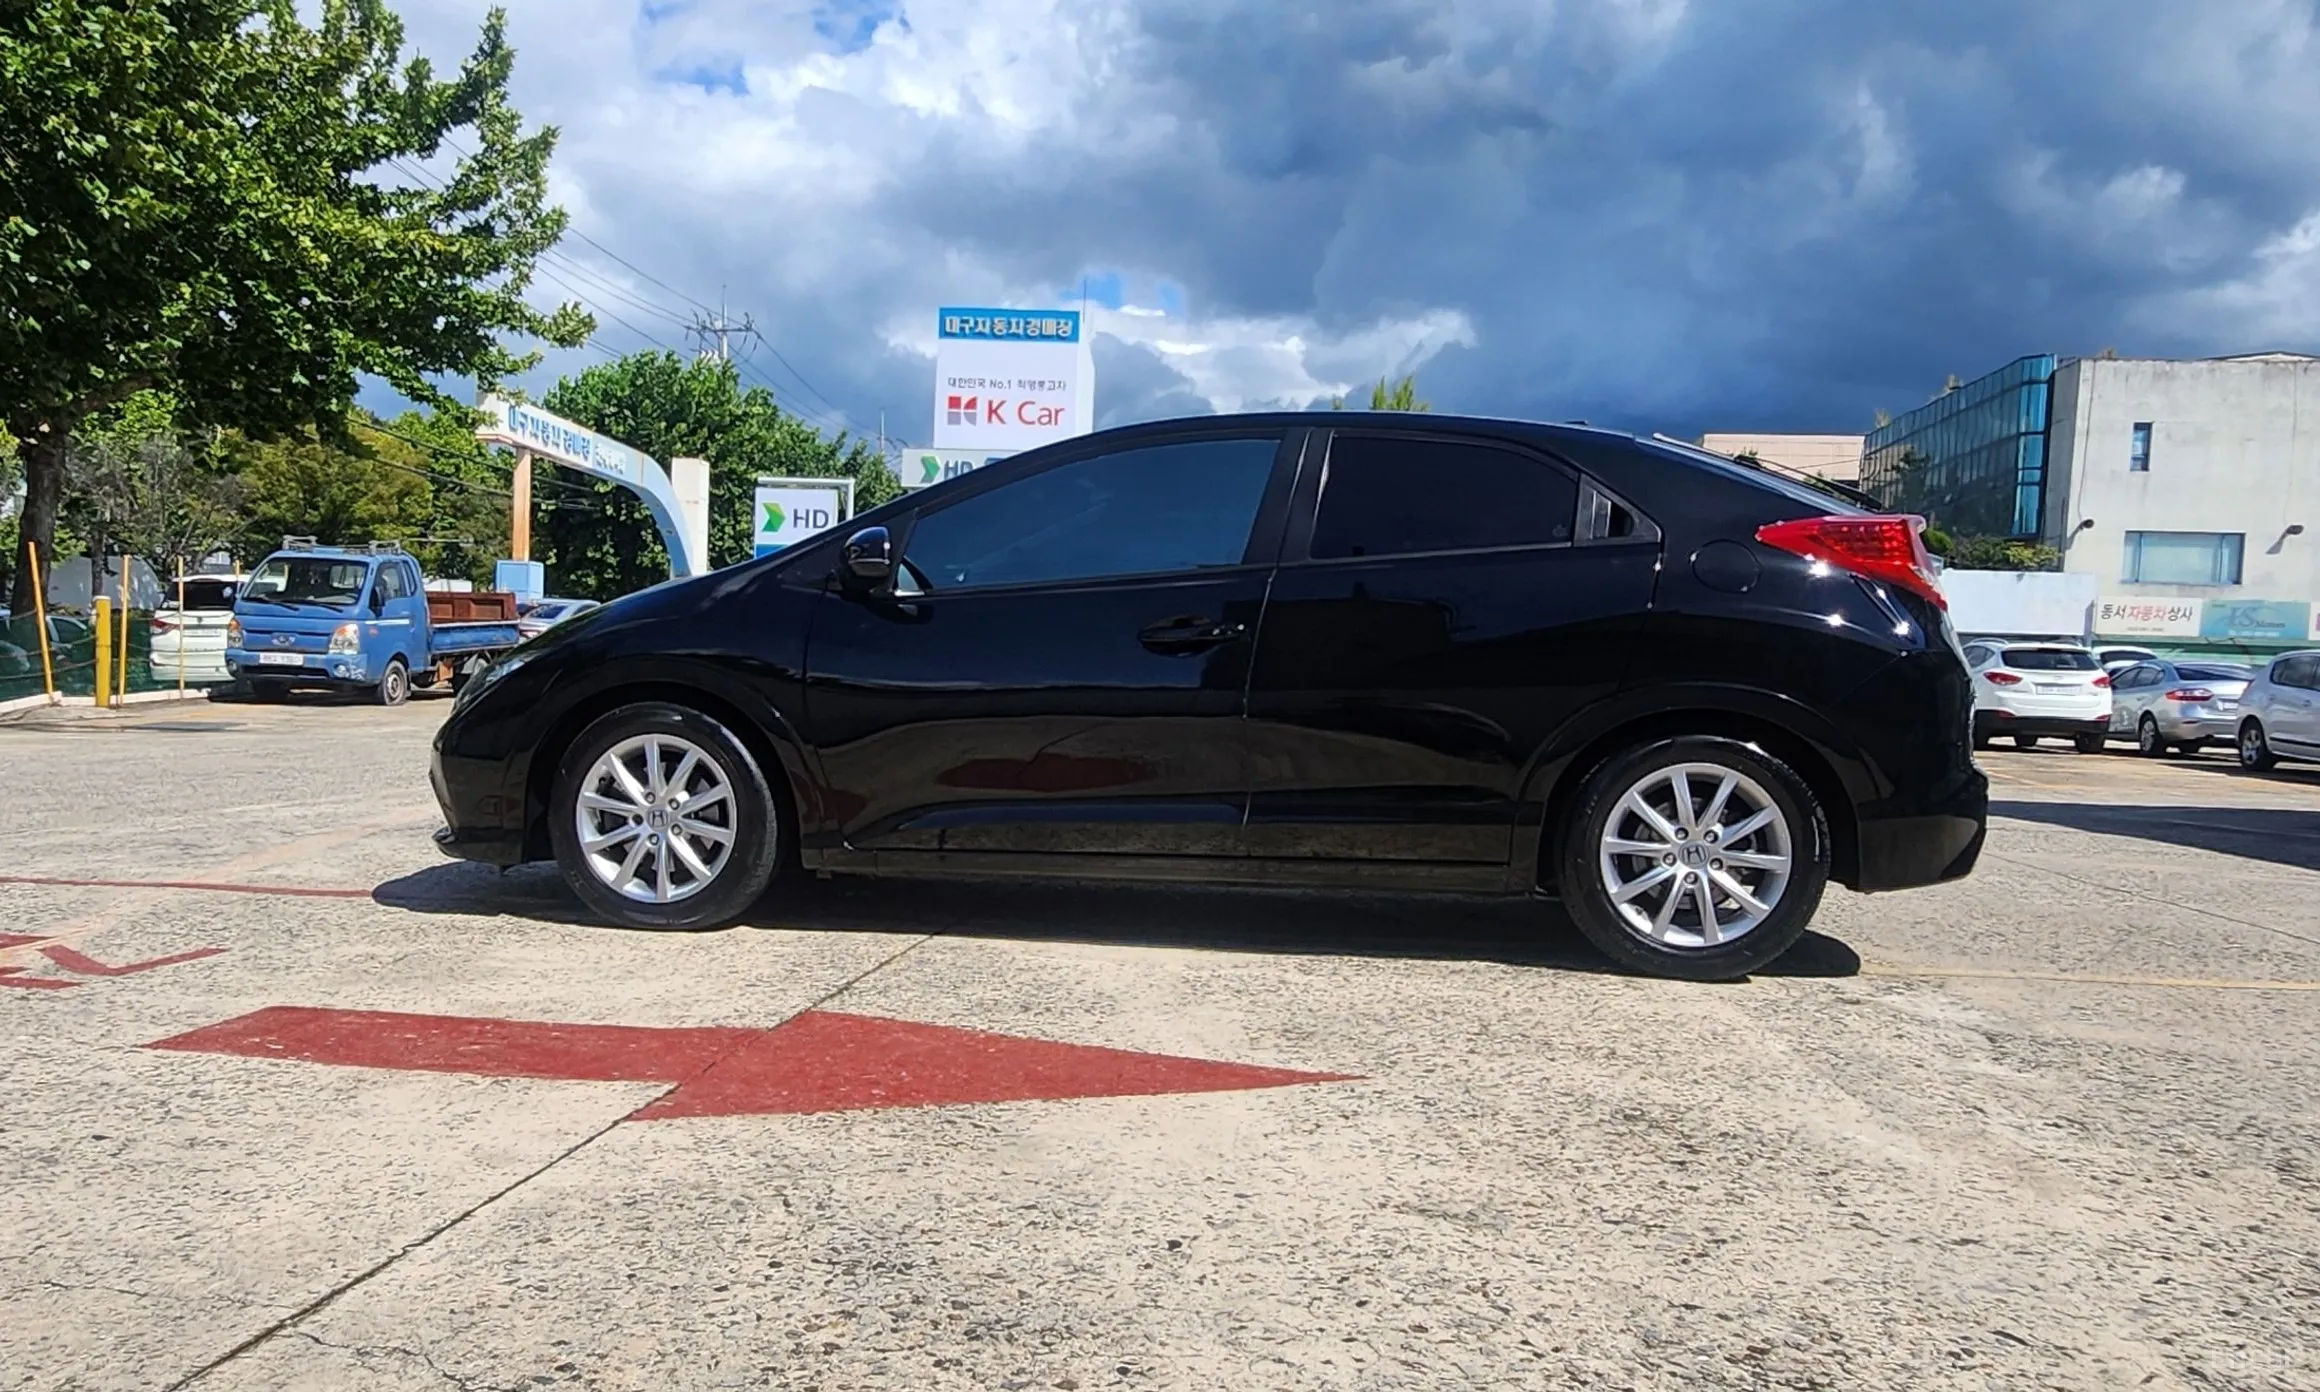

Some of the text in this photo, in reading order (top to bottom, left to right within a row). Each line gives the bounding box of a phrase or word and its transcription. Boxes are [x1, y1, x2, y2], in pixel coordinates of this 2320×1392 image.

[948, 377, 986, 389] 대한민국
[990, 379, 1012, 390] No.1
[987, 400, 1065, 426] K Car
[793, 508, 829, 528] HD
